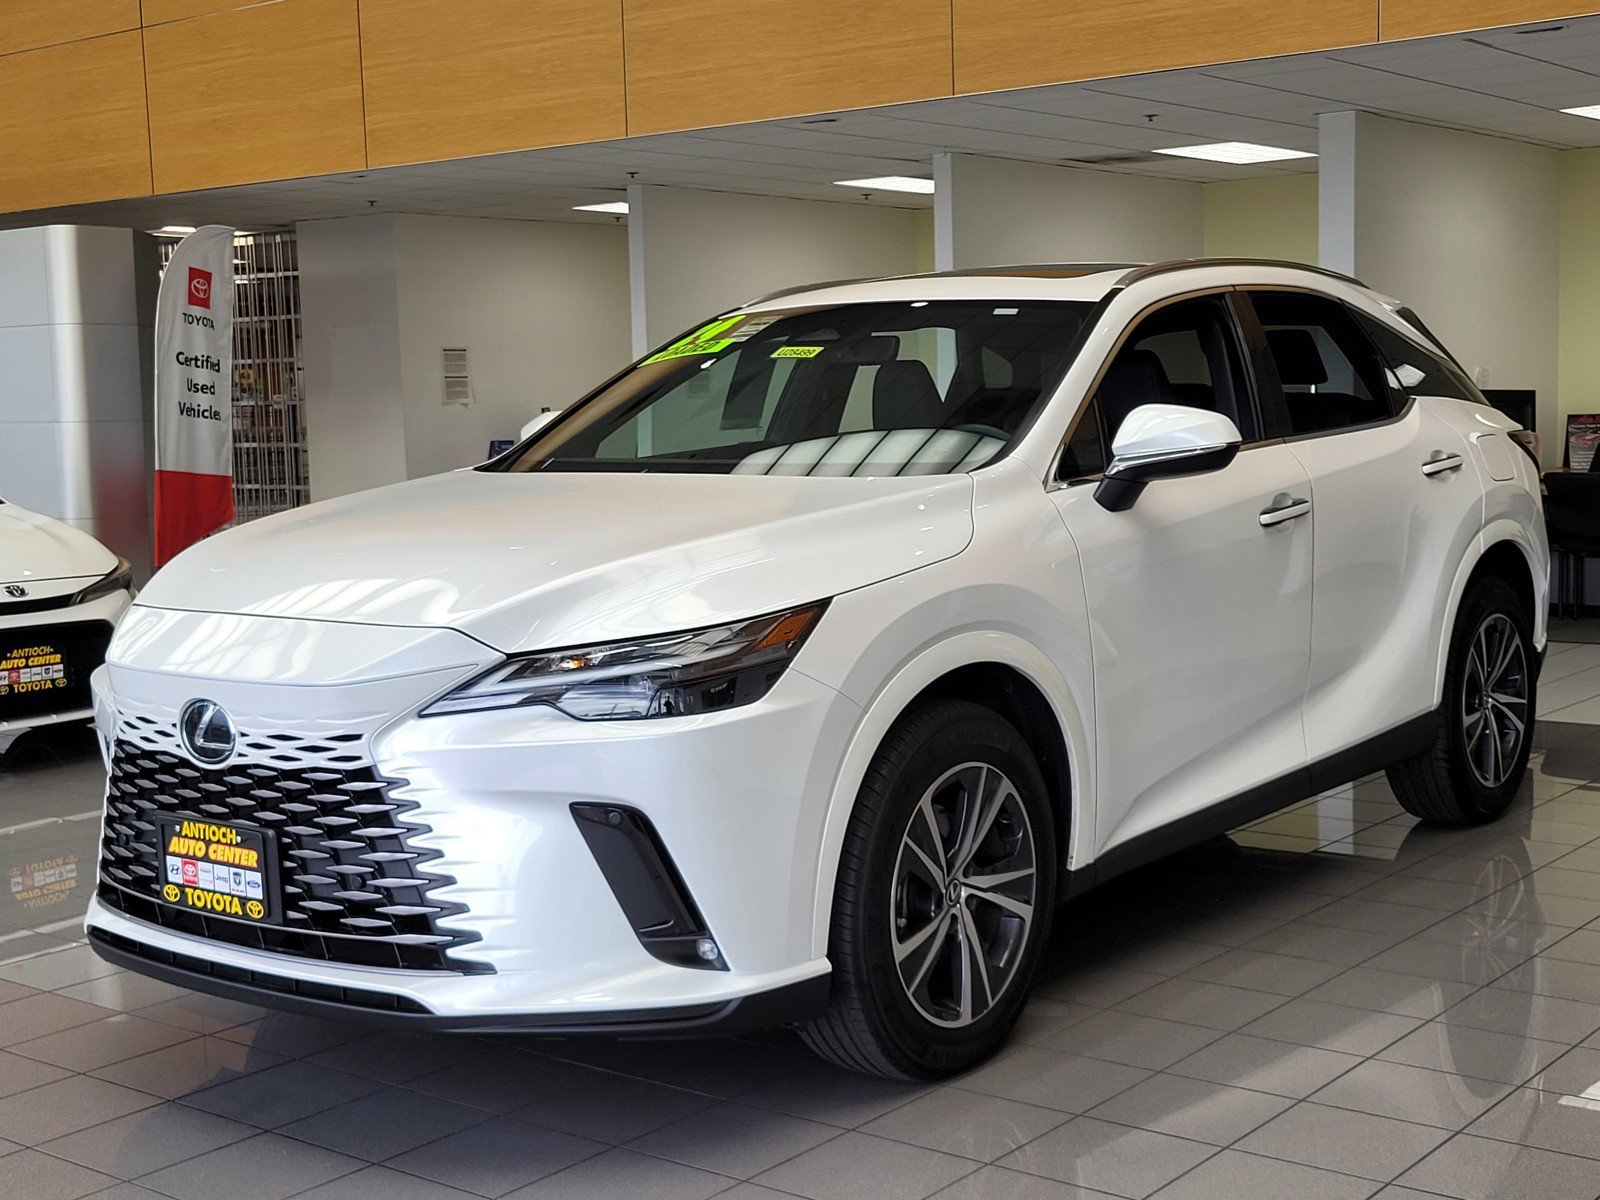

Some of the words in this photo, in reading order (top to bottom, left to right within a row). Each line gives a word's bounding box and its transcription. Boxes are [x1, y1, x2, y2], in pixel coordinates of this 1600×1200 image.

[182, 312, 215, 330] TOYOTA
[175, 351, 221, 373] Certified
[186, 377, 216, 396] Used
[178, 401, 222, 422] Vehicles
[0, 658, 26, 669] AUTO
[28, 654, 62, 666] CENTER
[11, 645, 51, 659] ANTIOCH
[13, 680, 53, 694] TOYOTA
[181, 821, 237, 845] ANTIOCH
[168, 836, 206, 858] AUTO
[208, 843, 259, 868] CENTER
[185, 887, 243, 915] TOYOTA
